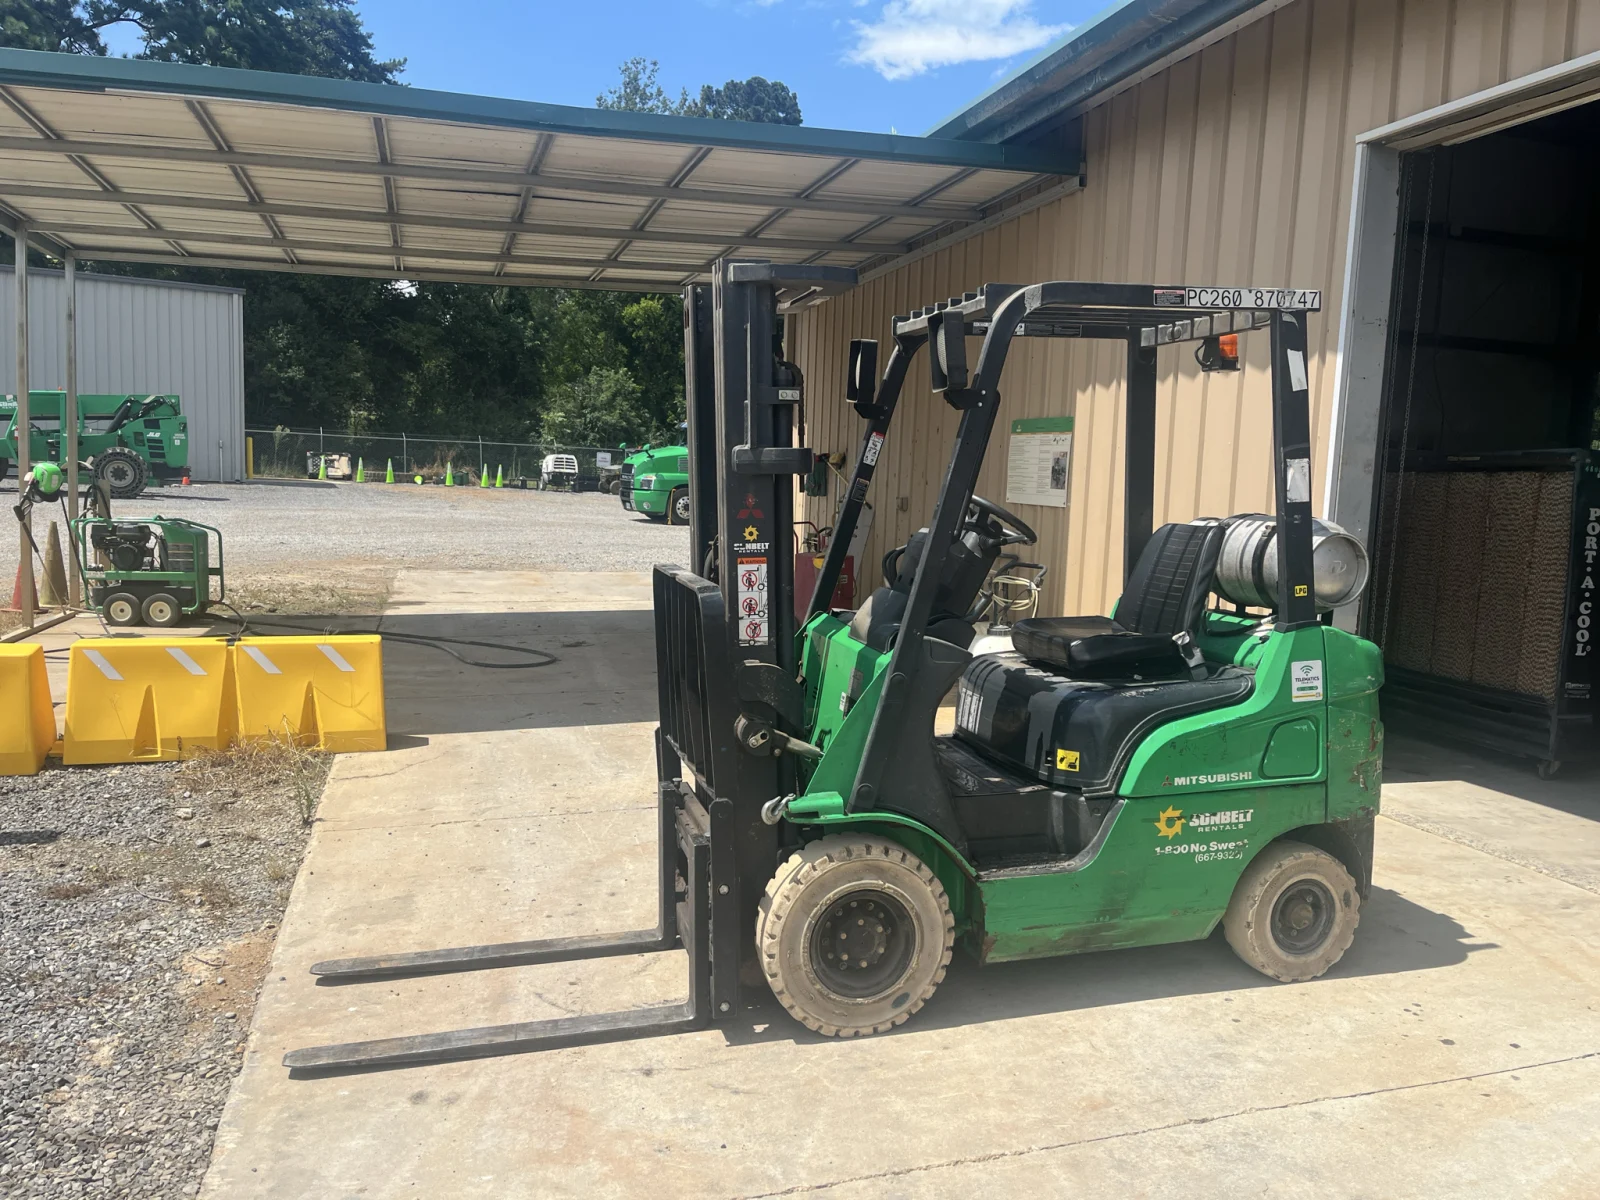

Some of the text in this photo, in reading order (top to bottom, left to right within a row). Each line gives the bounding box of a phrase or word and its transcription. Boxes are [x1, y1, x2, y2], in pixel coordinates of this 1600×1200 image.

[1187, 288, 1242, 307] PC260
[1254, 290, 1318, 308] 870747
[1174, 772, 1252, 786] MITSUBISHI
[1198, 824, 1244, 832] RENTALS
[1190, 843, 1207, 853] No
